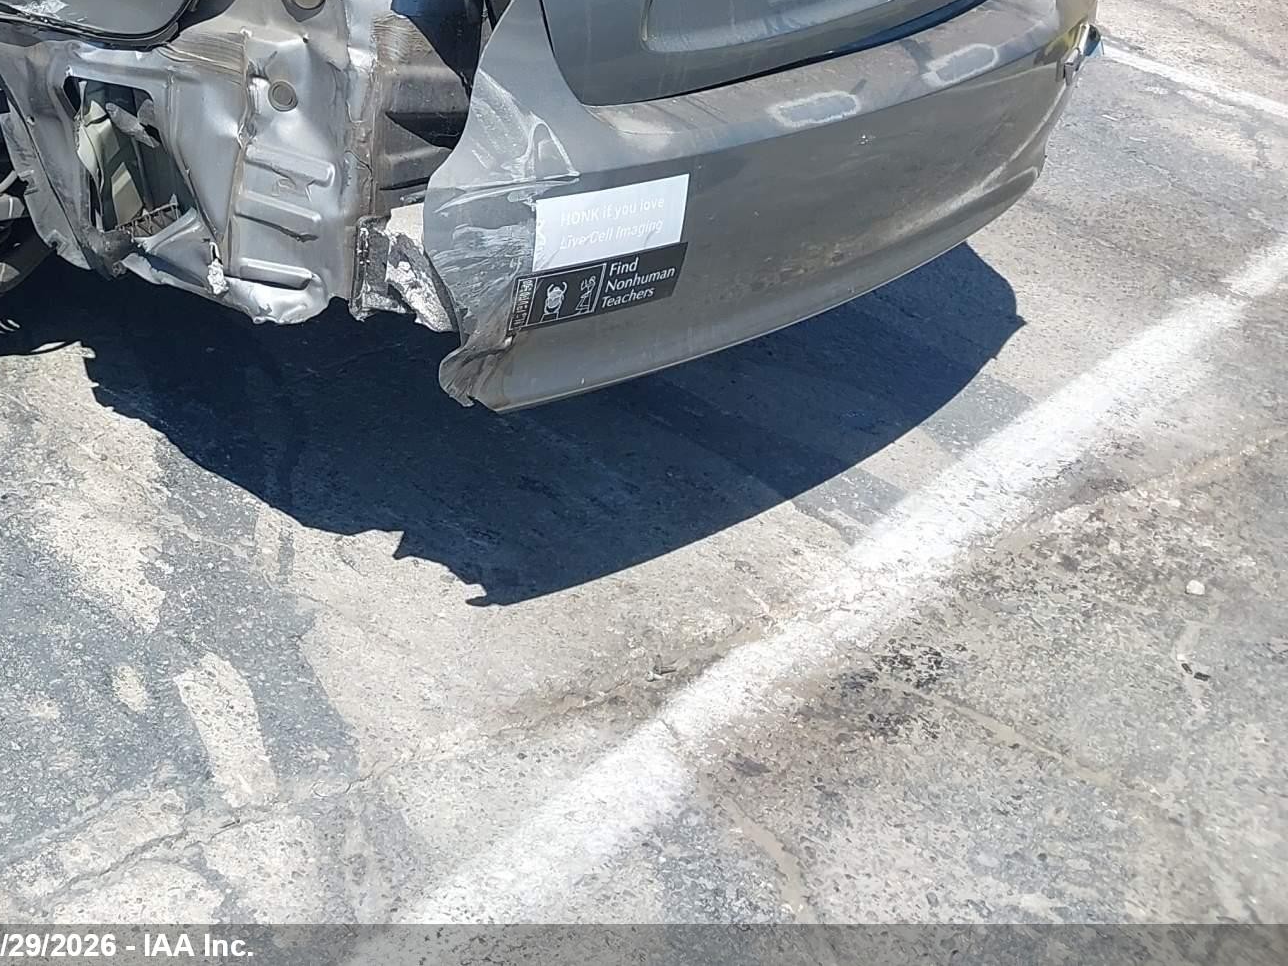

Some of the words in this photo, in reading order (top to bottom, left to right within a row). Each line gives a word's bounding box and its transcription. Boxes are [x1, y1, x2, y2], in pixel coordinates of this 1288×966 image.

[560, 207, 599, 227] HONK
[602, 203, 613, 219] if
[614, 201, 637, 220] you
[639, 197, 665, 213] love
[615, 218, 664, 240] Imaging
[609, 256, 639, 276] Find
[605, 267, 676, 293] Nonhuman
[601, 287, 655, 308] Teachers
